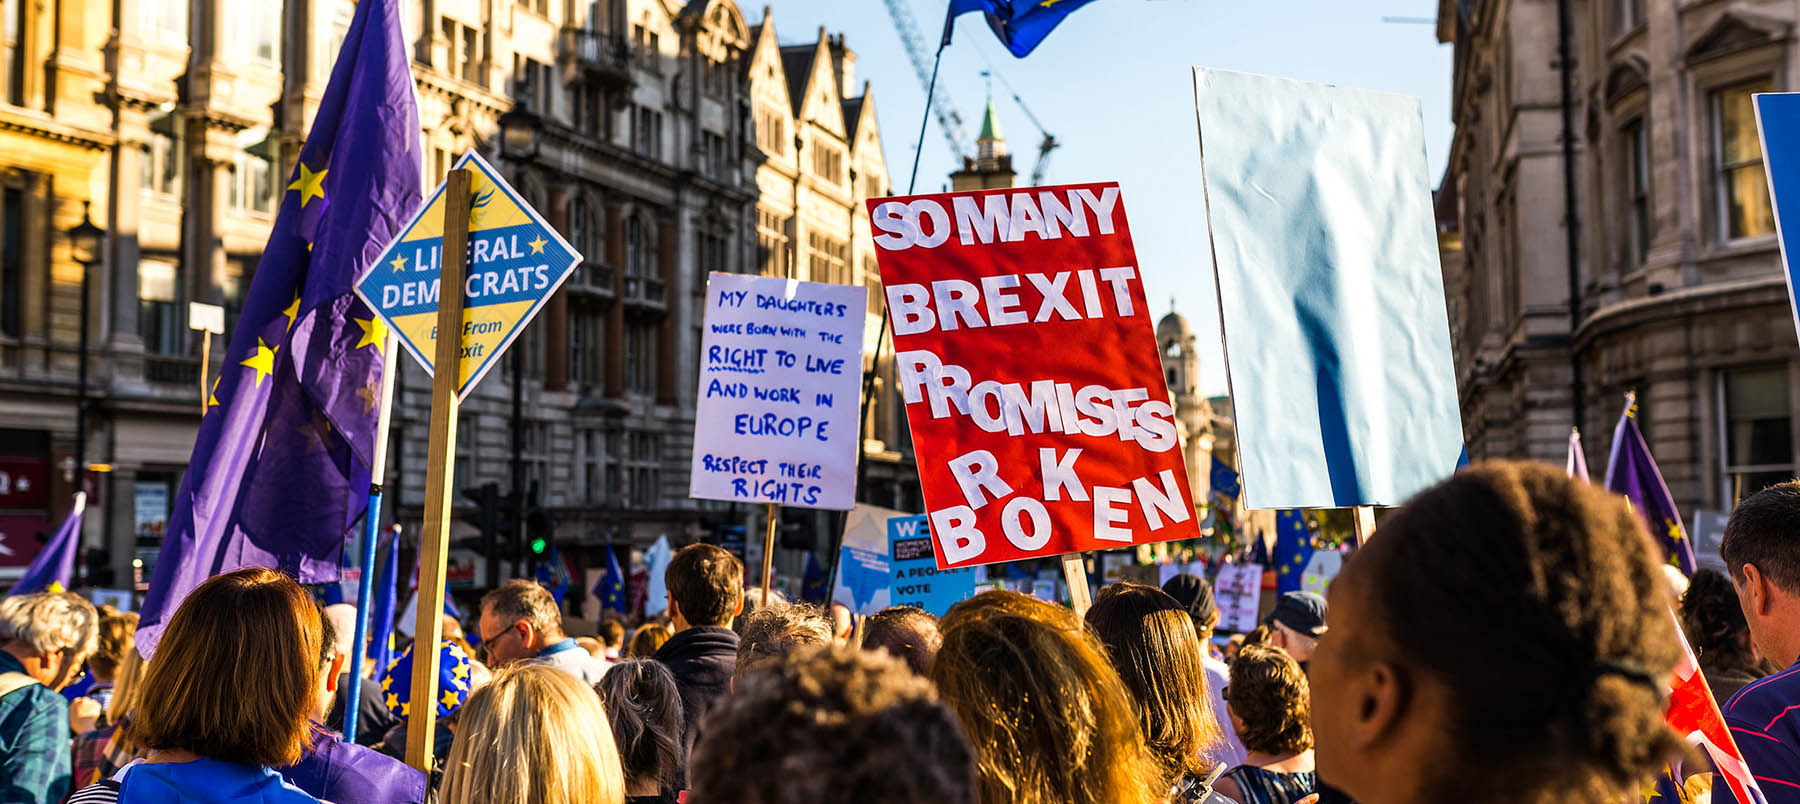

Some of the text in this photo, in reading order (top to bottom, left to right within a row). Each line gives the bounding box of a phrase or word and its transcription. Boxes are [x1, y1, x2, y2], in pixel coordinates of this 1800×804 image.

[872, 187, 1120, 250] SO MANY
[382, 264, 549, 309] DEMCRATS
[718, 290, 847, 318] MY DAUGHTERS
[885, 266, 1136, 336] BREXIT
[463, 320, 502, 337] From
[712, 322, 844, 344] WERE BORN WITH THE
[709, 345, 845, 374] RIGHT TO LIVE
[707, 378, 833, 408] AND WORK IN
[896, 350, 1177, 452] PROMISES
[734, 412, 830, 442] EUROPE
[702, 453, 822, 479] RESPECT THEIR
[732, 478, 822, 505] RIGHTS
[896, 569, 905, 579] A
[896, 583, 931, 596] VOTE
